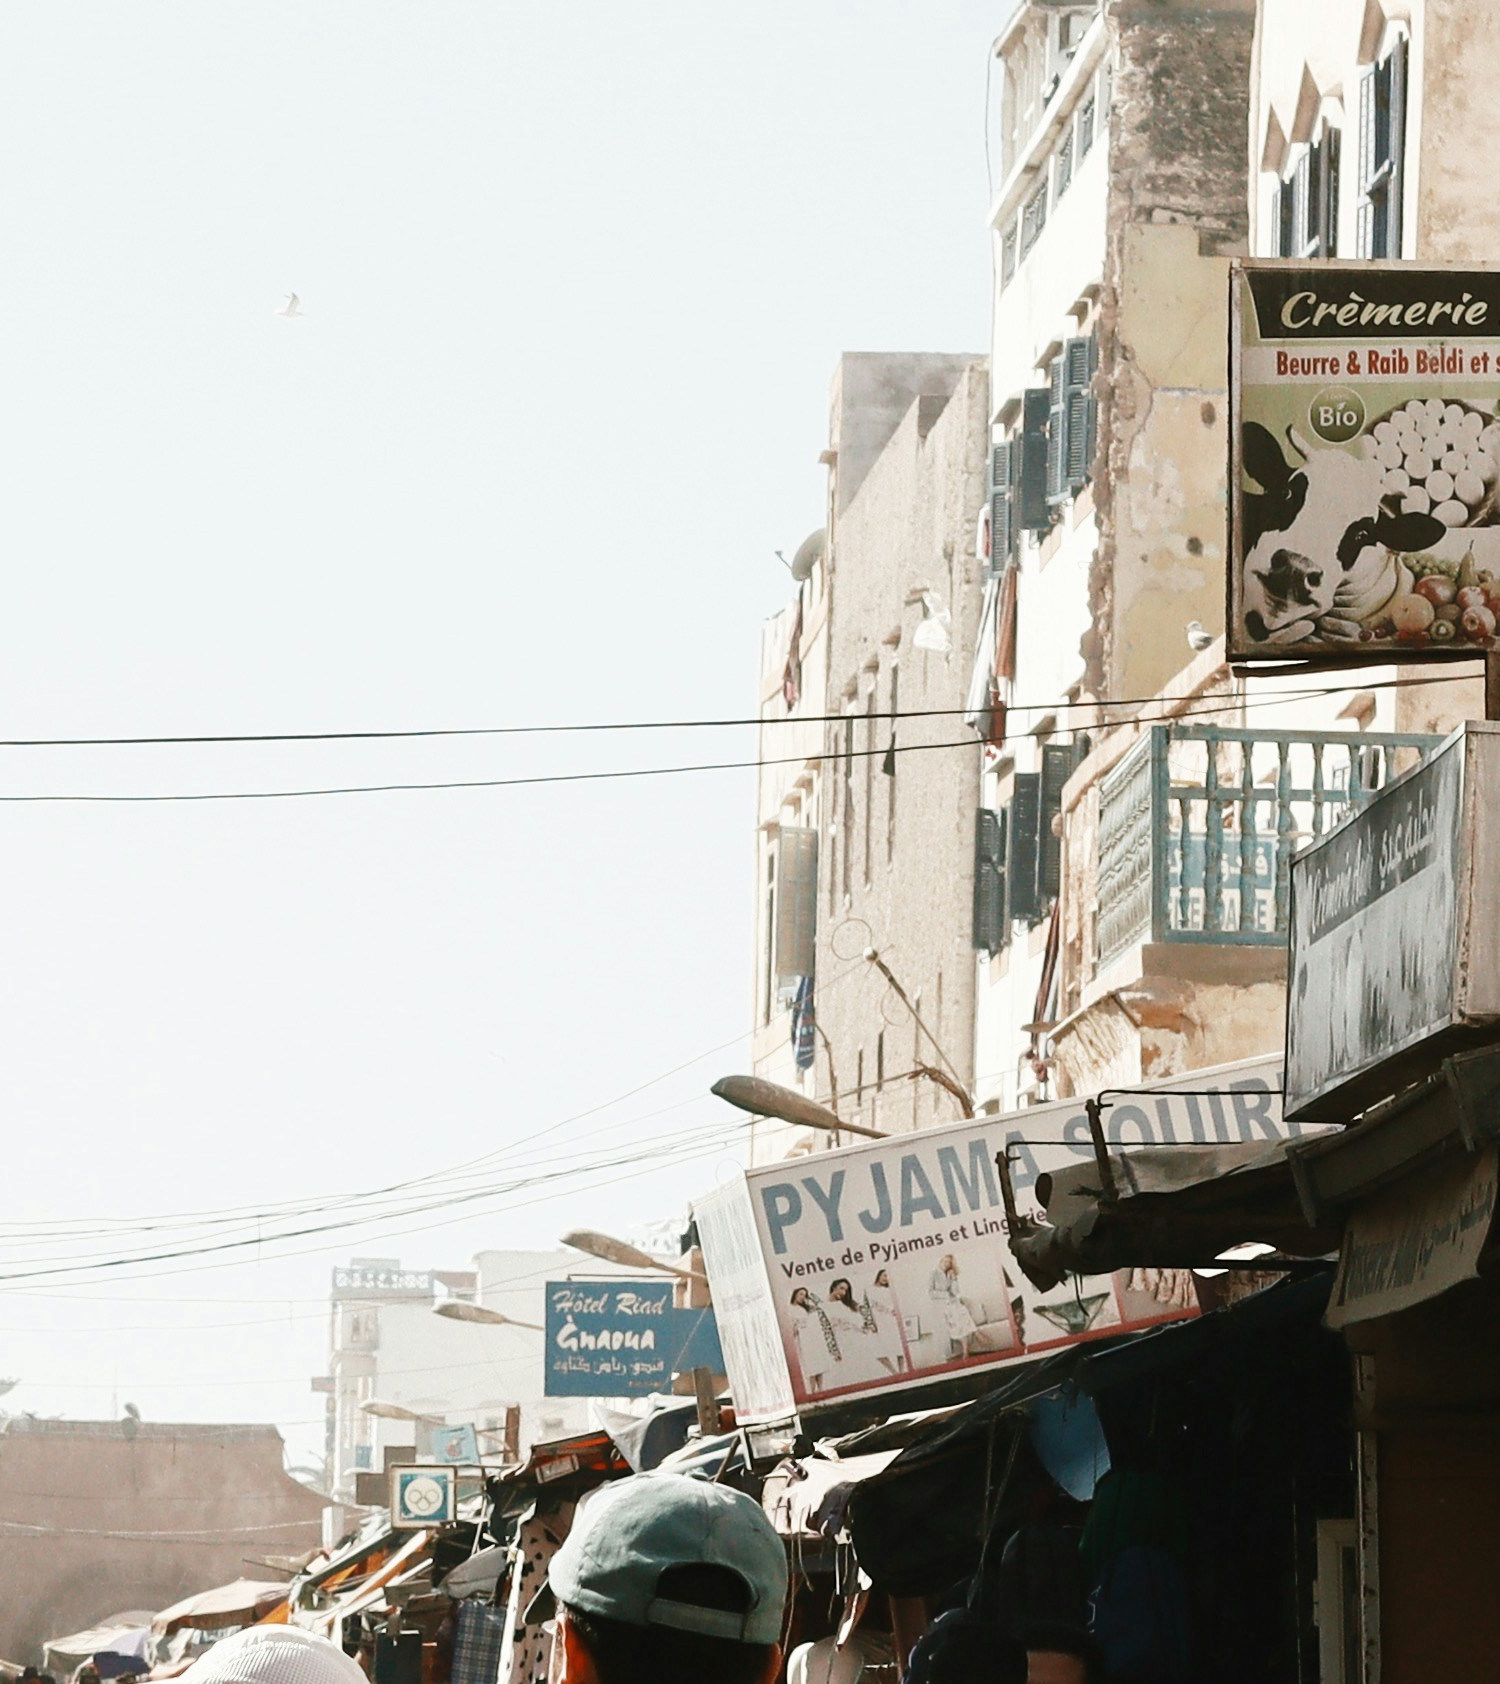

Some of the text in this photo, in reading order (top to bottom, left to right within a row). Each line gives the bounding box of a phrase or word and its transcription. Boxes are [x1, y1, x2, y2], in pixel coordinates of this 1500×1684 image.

[1280, 290, 1488, 329] Crèmerie
[1276, 350, 1340, 377] Beurre
[1346, 350, 1361, 375] &
[1367, 348, 1410, 375] Raib
[1416, 347, 1464, 375] Beldi
[1470, 350, 1489, 375] et
[1318, 401, 1358, 427] Bio
[761, 1070, 1303, 1255] PYJAMA SOUIR
[781, 1256, 835, 1279] Vente
[841, 1248, 864, 1267] de
[869, 1231, 944, 1262] Pyjamas
[949, 1225, 967, 1242] et
[552, 1289, 668, 1316] Hôtel Riad
